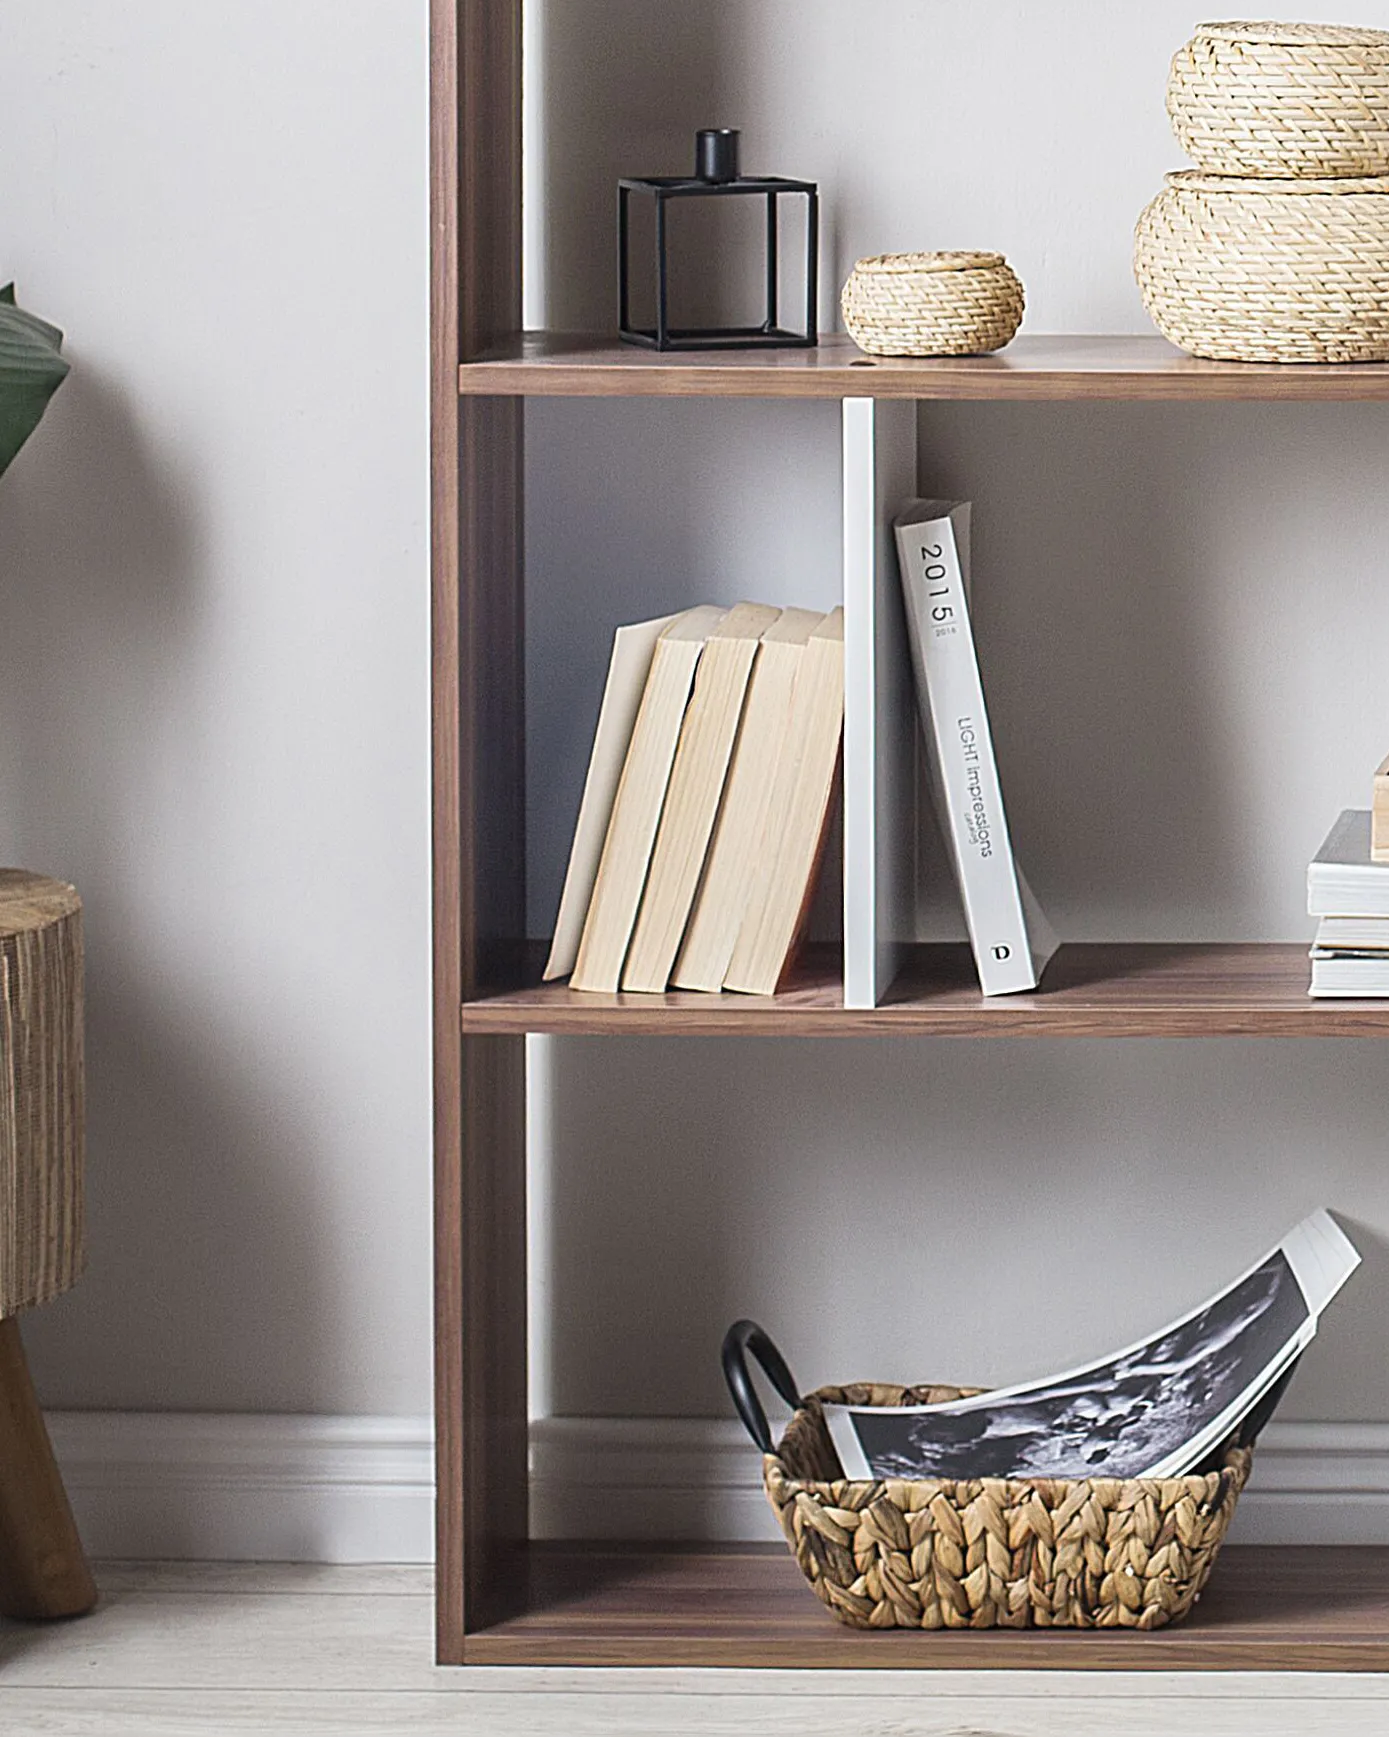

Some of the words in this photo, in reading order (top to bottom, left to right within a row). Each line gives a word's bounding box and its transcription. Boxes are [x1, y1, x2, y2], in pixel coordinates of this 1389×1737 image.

[919, 543, 954, 622] 2015
[956, 715, 979, 762] LIGHT
[964, 765, 994, 858] impressions
